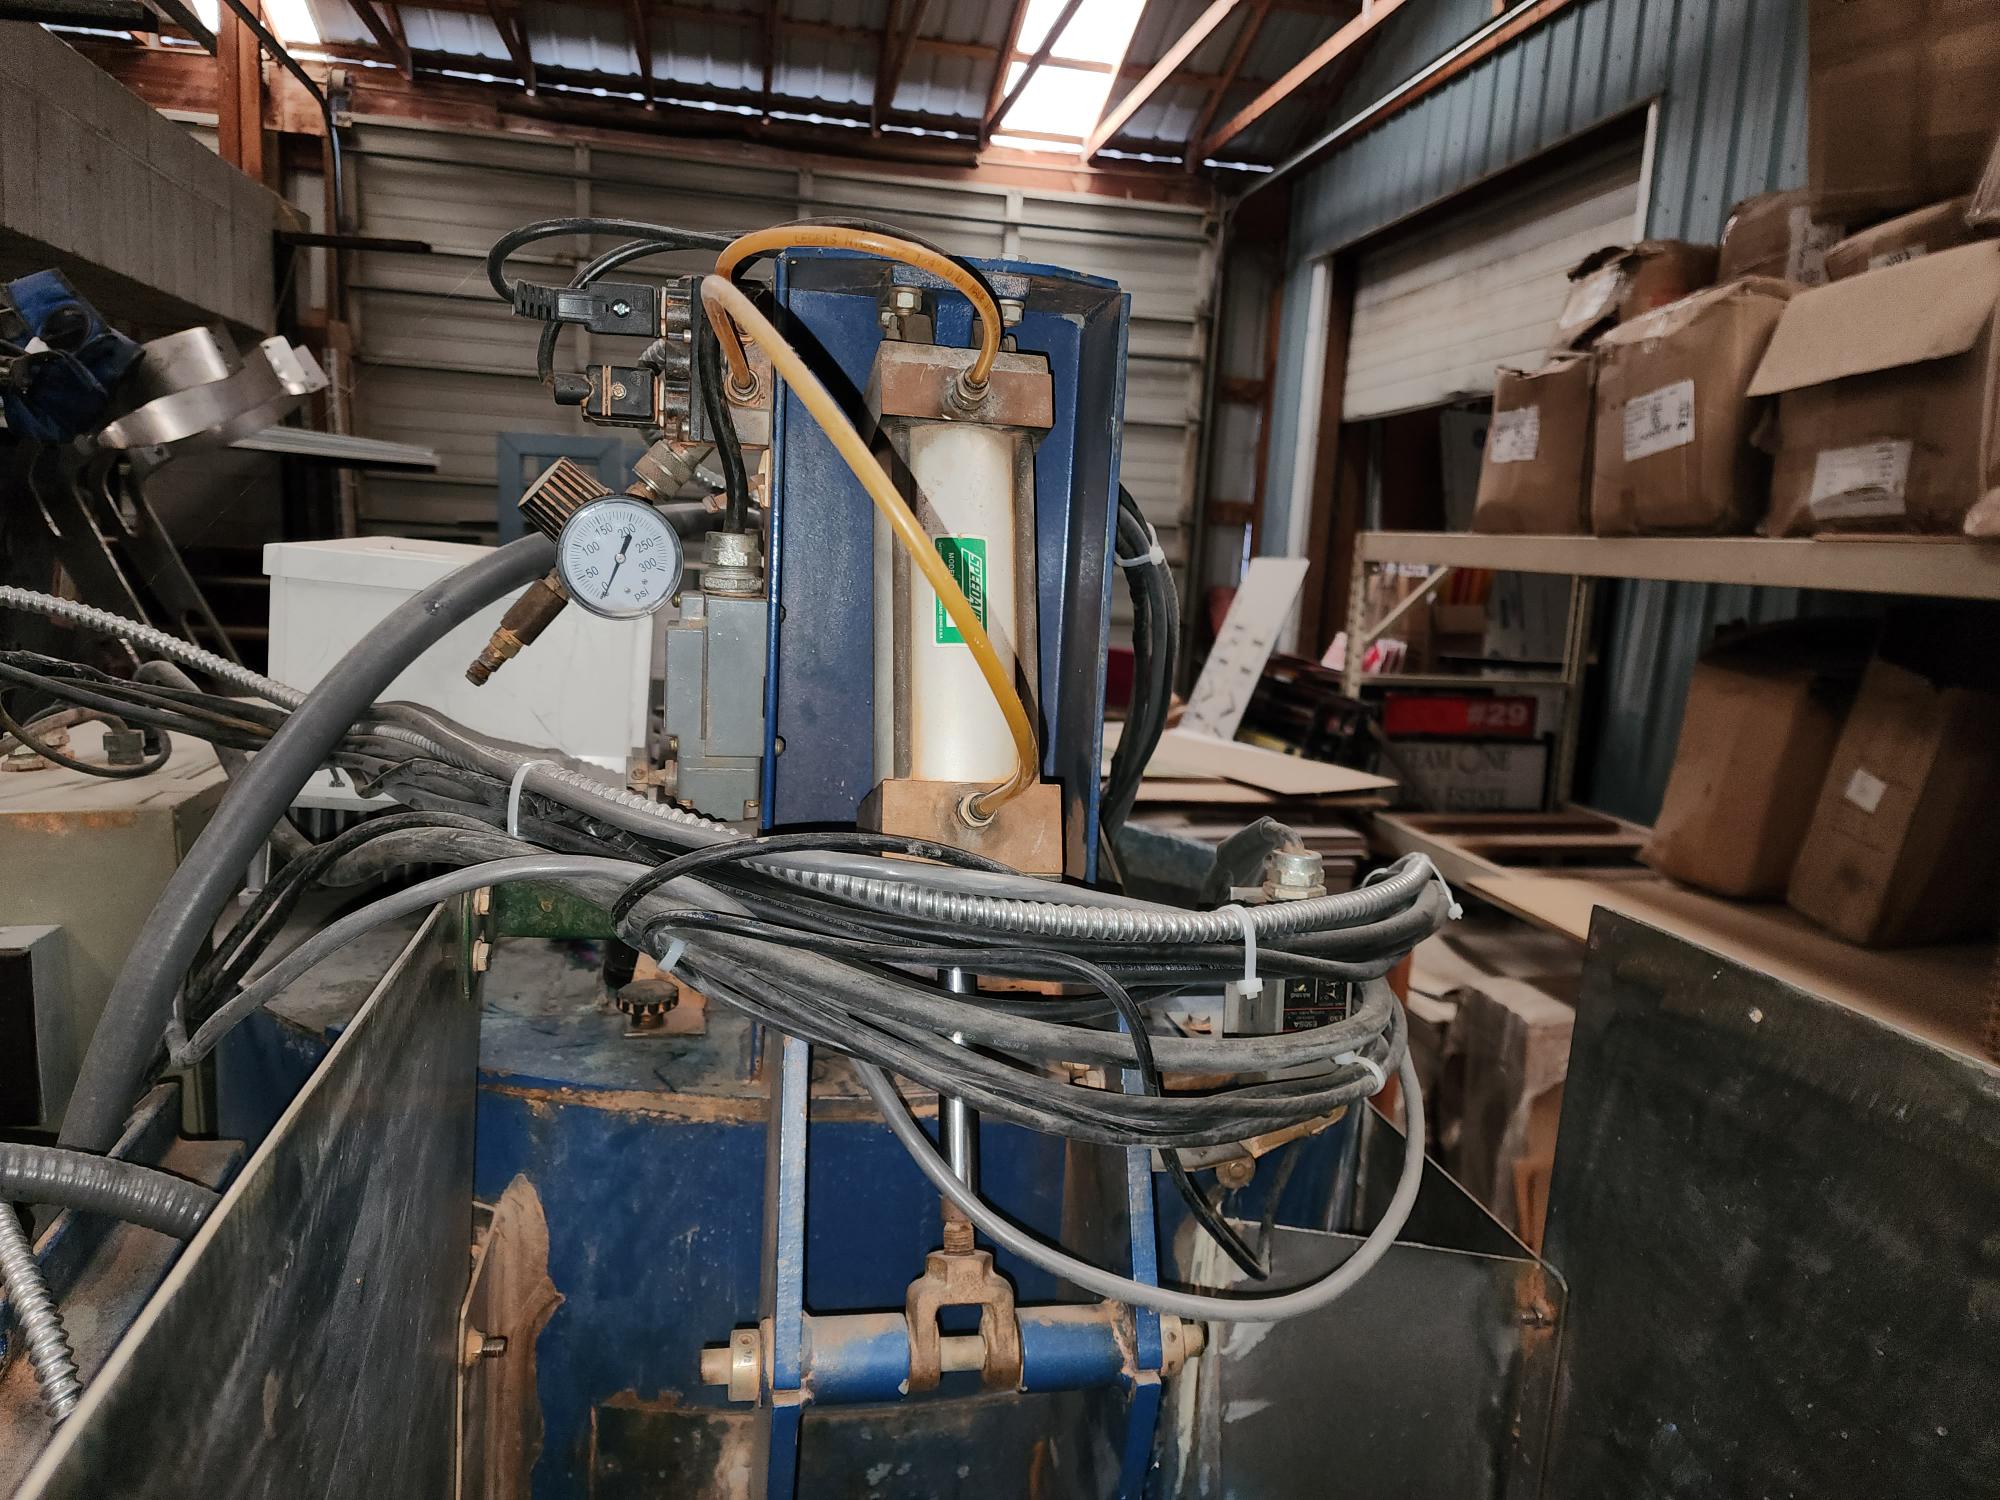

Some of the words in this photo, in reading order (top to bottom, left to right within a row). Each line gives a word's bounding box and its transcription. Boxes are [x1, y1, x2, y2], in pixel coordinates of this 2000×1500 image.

[594, 522, 613, 537] 150
[617, 522, 636, 539] 200
[582, 541, 600, 557] 100
[635, 537, 654, 554] 250
[585, 566, 599, 579] 50
[638, 557, 657, 573] 300
[601, 581, 610, 593] 0
[633, 588, 650, 602] psi
[969, 553, 982, 623] SPEEDAIR
[1467, 703, 1529, 726] #29
